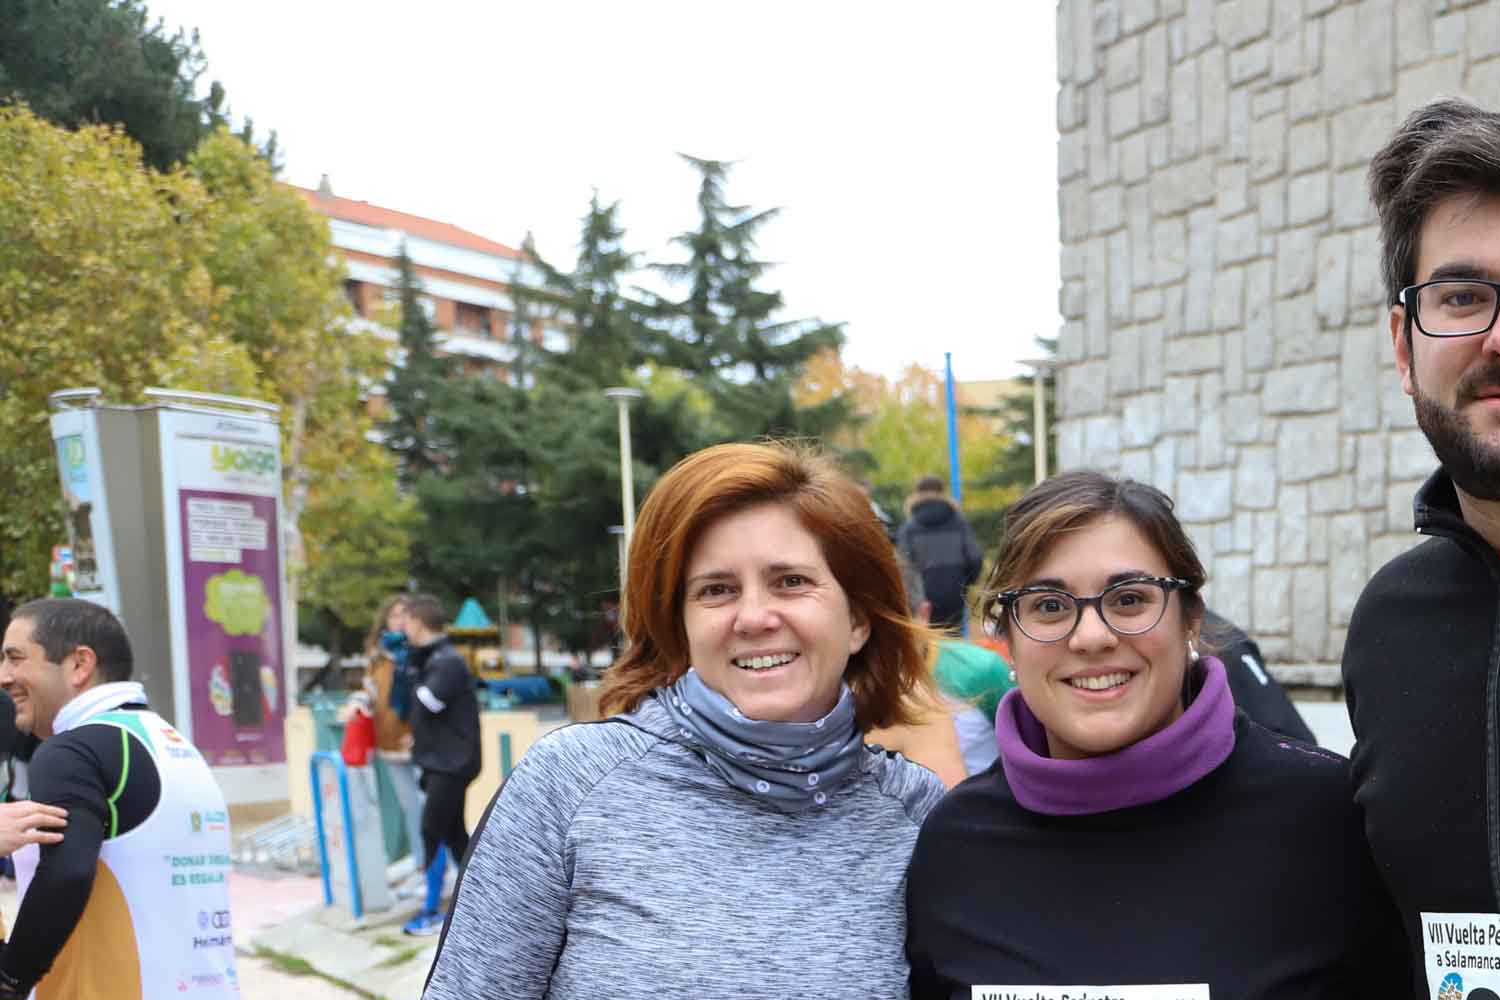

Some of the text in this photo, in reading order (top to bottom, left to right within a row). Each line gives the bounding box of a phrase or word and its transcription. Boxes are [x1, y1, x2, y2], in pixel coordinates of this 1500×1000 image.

[1427, 922, 1444, 945] VII
[1447, 922, 1486, 946] Vuelta
[1436, 955, 1443, 967] a
